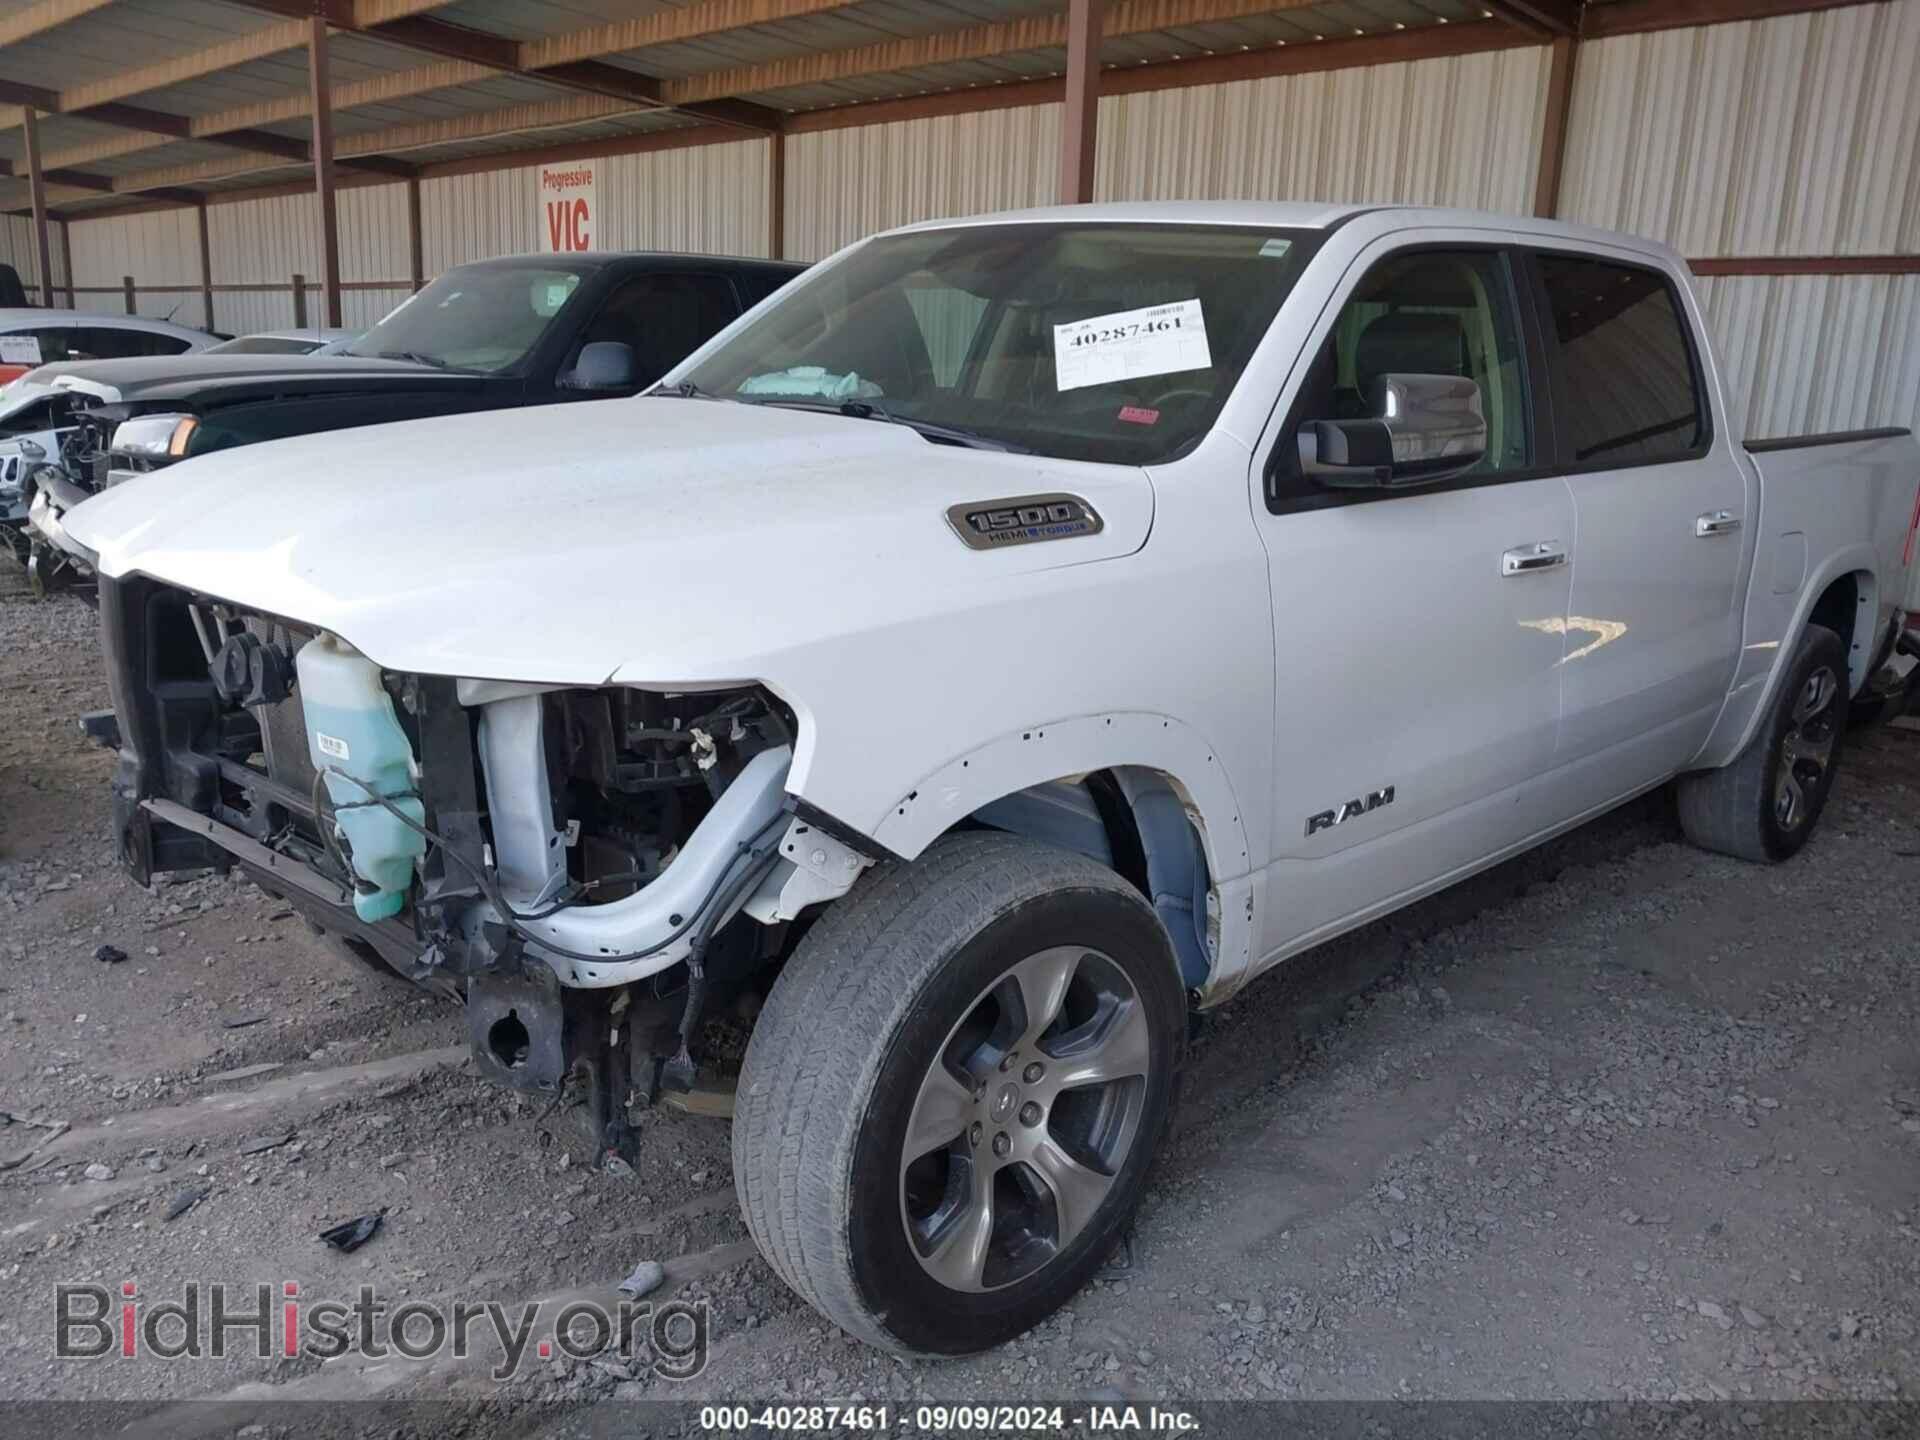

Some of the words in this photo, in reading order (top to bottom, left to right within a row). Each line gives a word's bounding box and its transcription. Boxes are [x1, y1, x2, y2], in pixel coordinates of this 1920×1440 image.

[543, 169, 592, 192] Progressive
[547, 198, 589, 252] VIC
[1069, 317, 1181, 347] 40287461
[970, 503, 1070, 531] 1500
[1304, 784, 1395, 838] RAM
